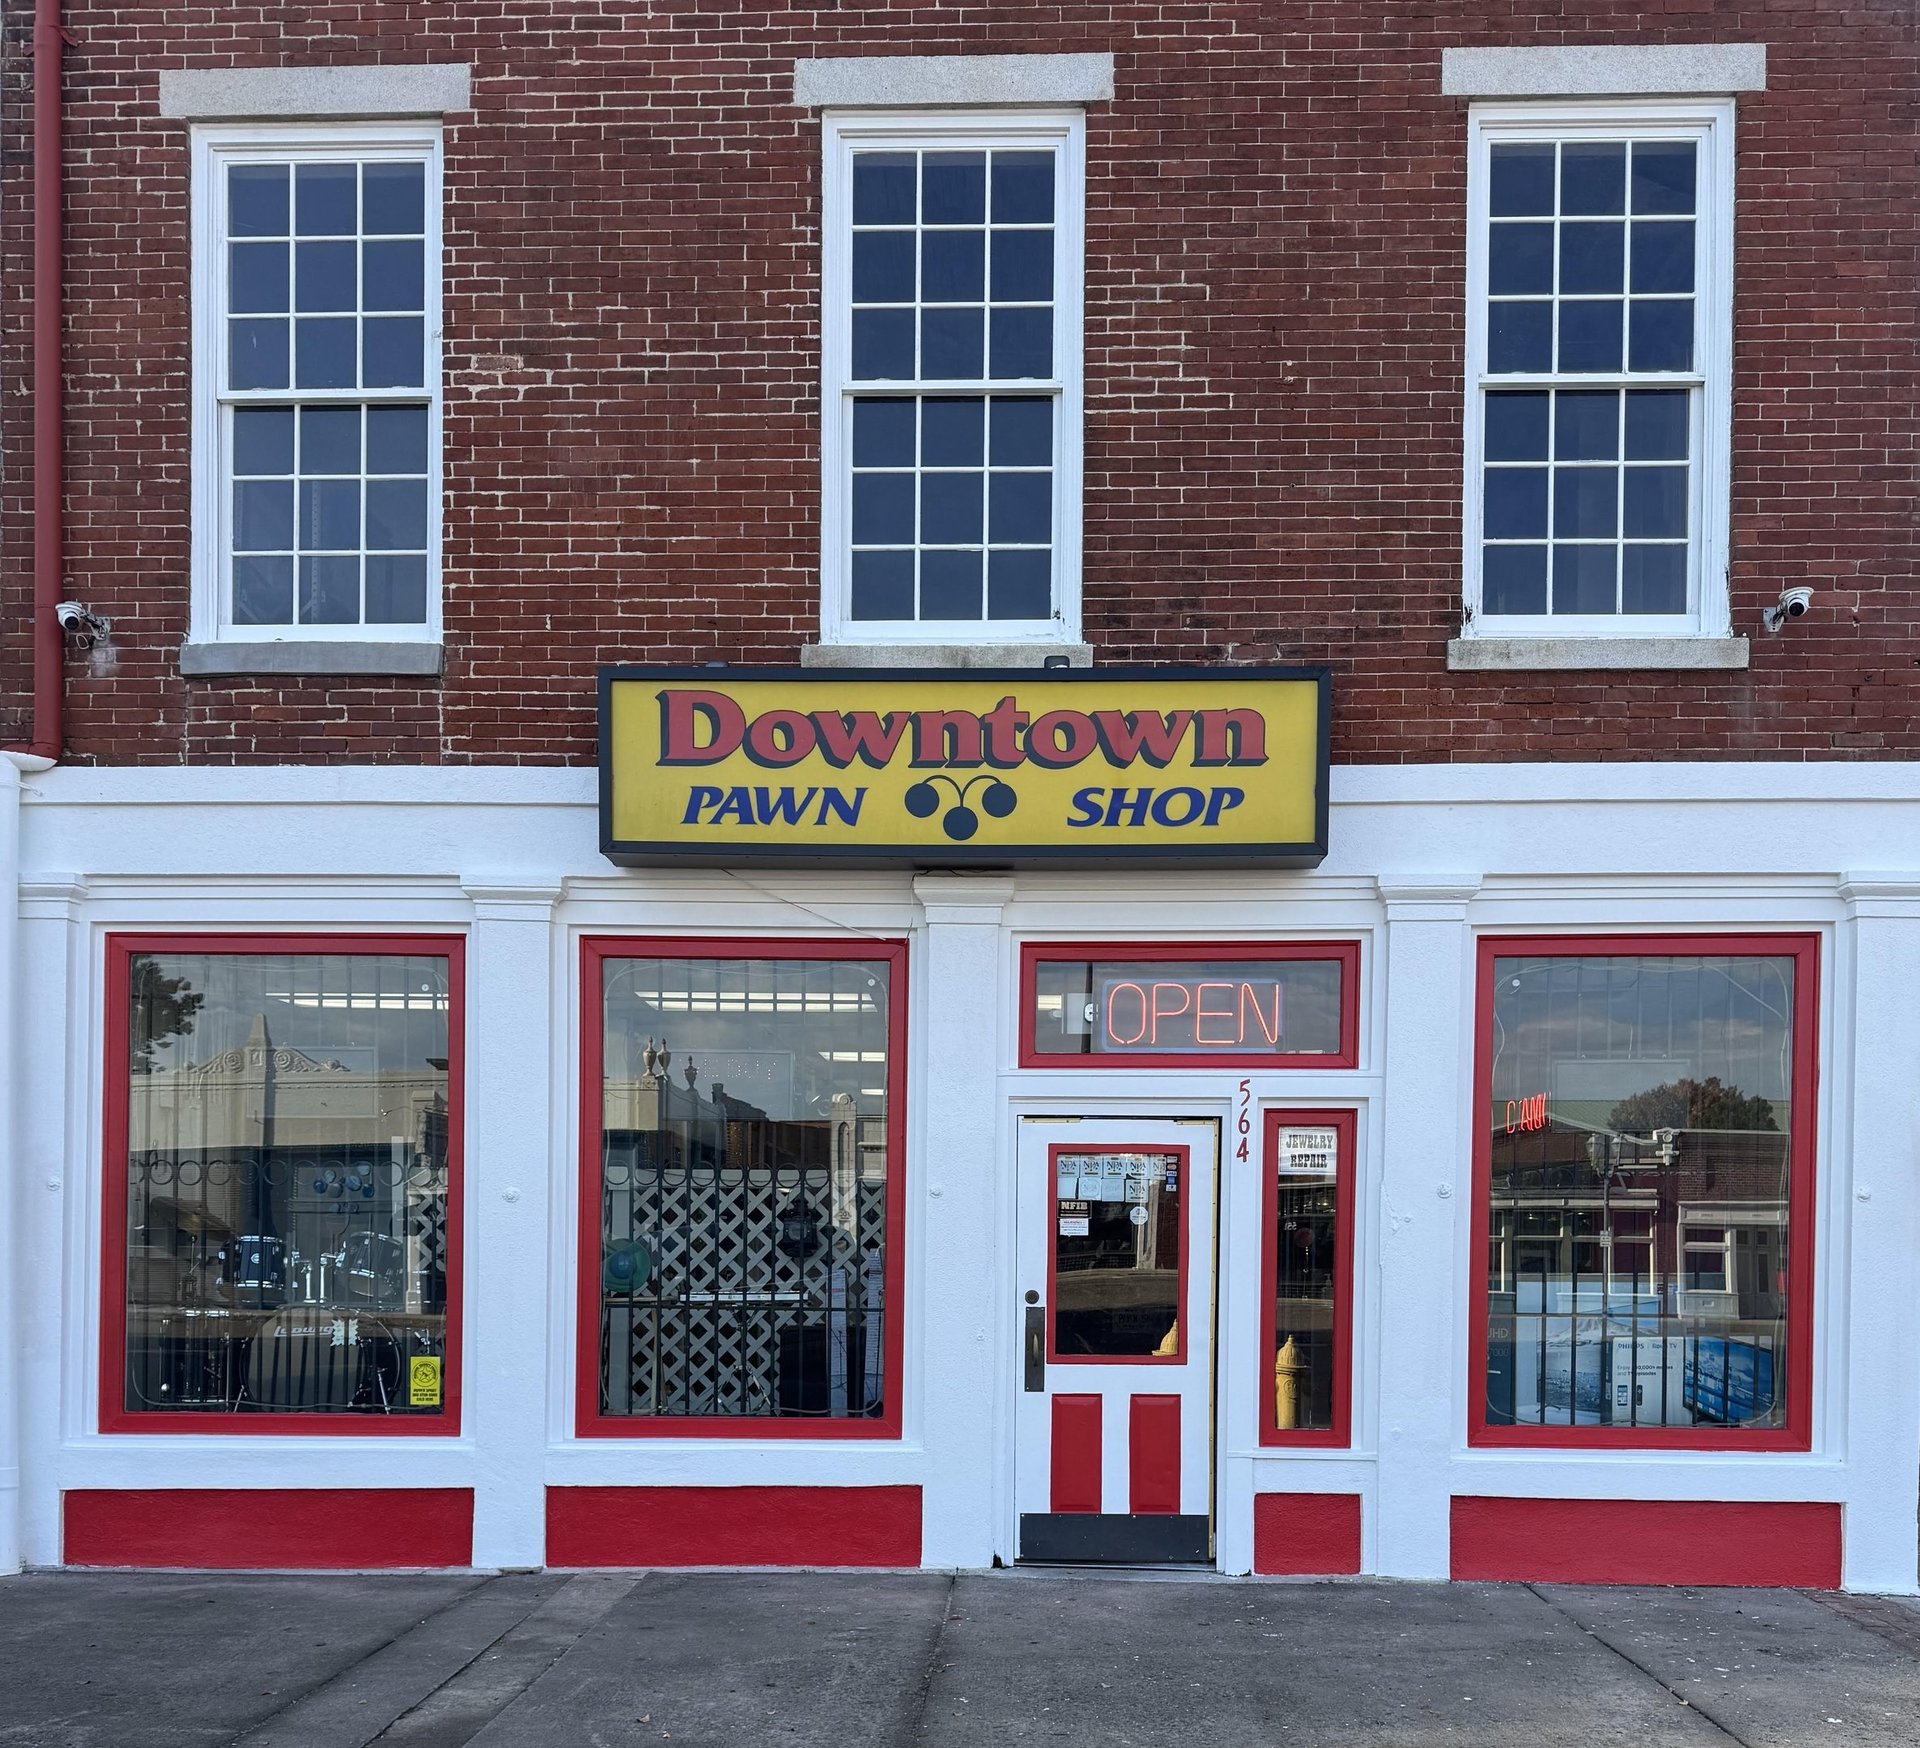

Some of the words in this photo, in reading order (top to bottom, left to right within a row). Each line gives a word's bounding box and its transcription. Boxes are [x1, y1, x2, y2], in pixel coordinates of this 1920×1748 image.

[655, 689, 1269, 768] Downtown
[681, 785, 868, 827] PAWN
[1066, 785, 1247, 829] SHOP
[1108, 983, 1279, 1044] OPEN
[1236, 1079, 1251, 1163] 564
[1286, 1134, 1333, 1149] JEWELRY
[1290, 1153, 1328, 1168] REPAIR
